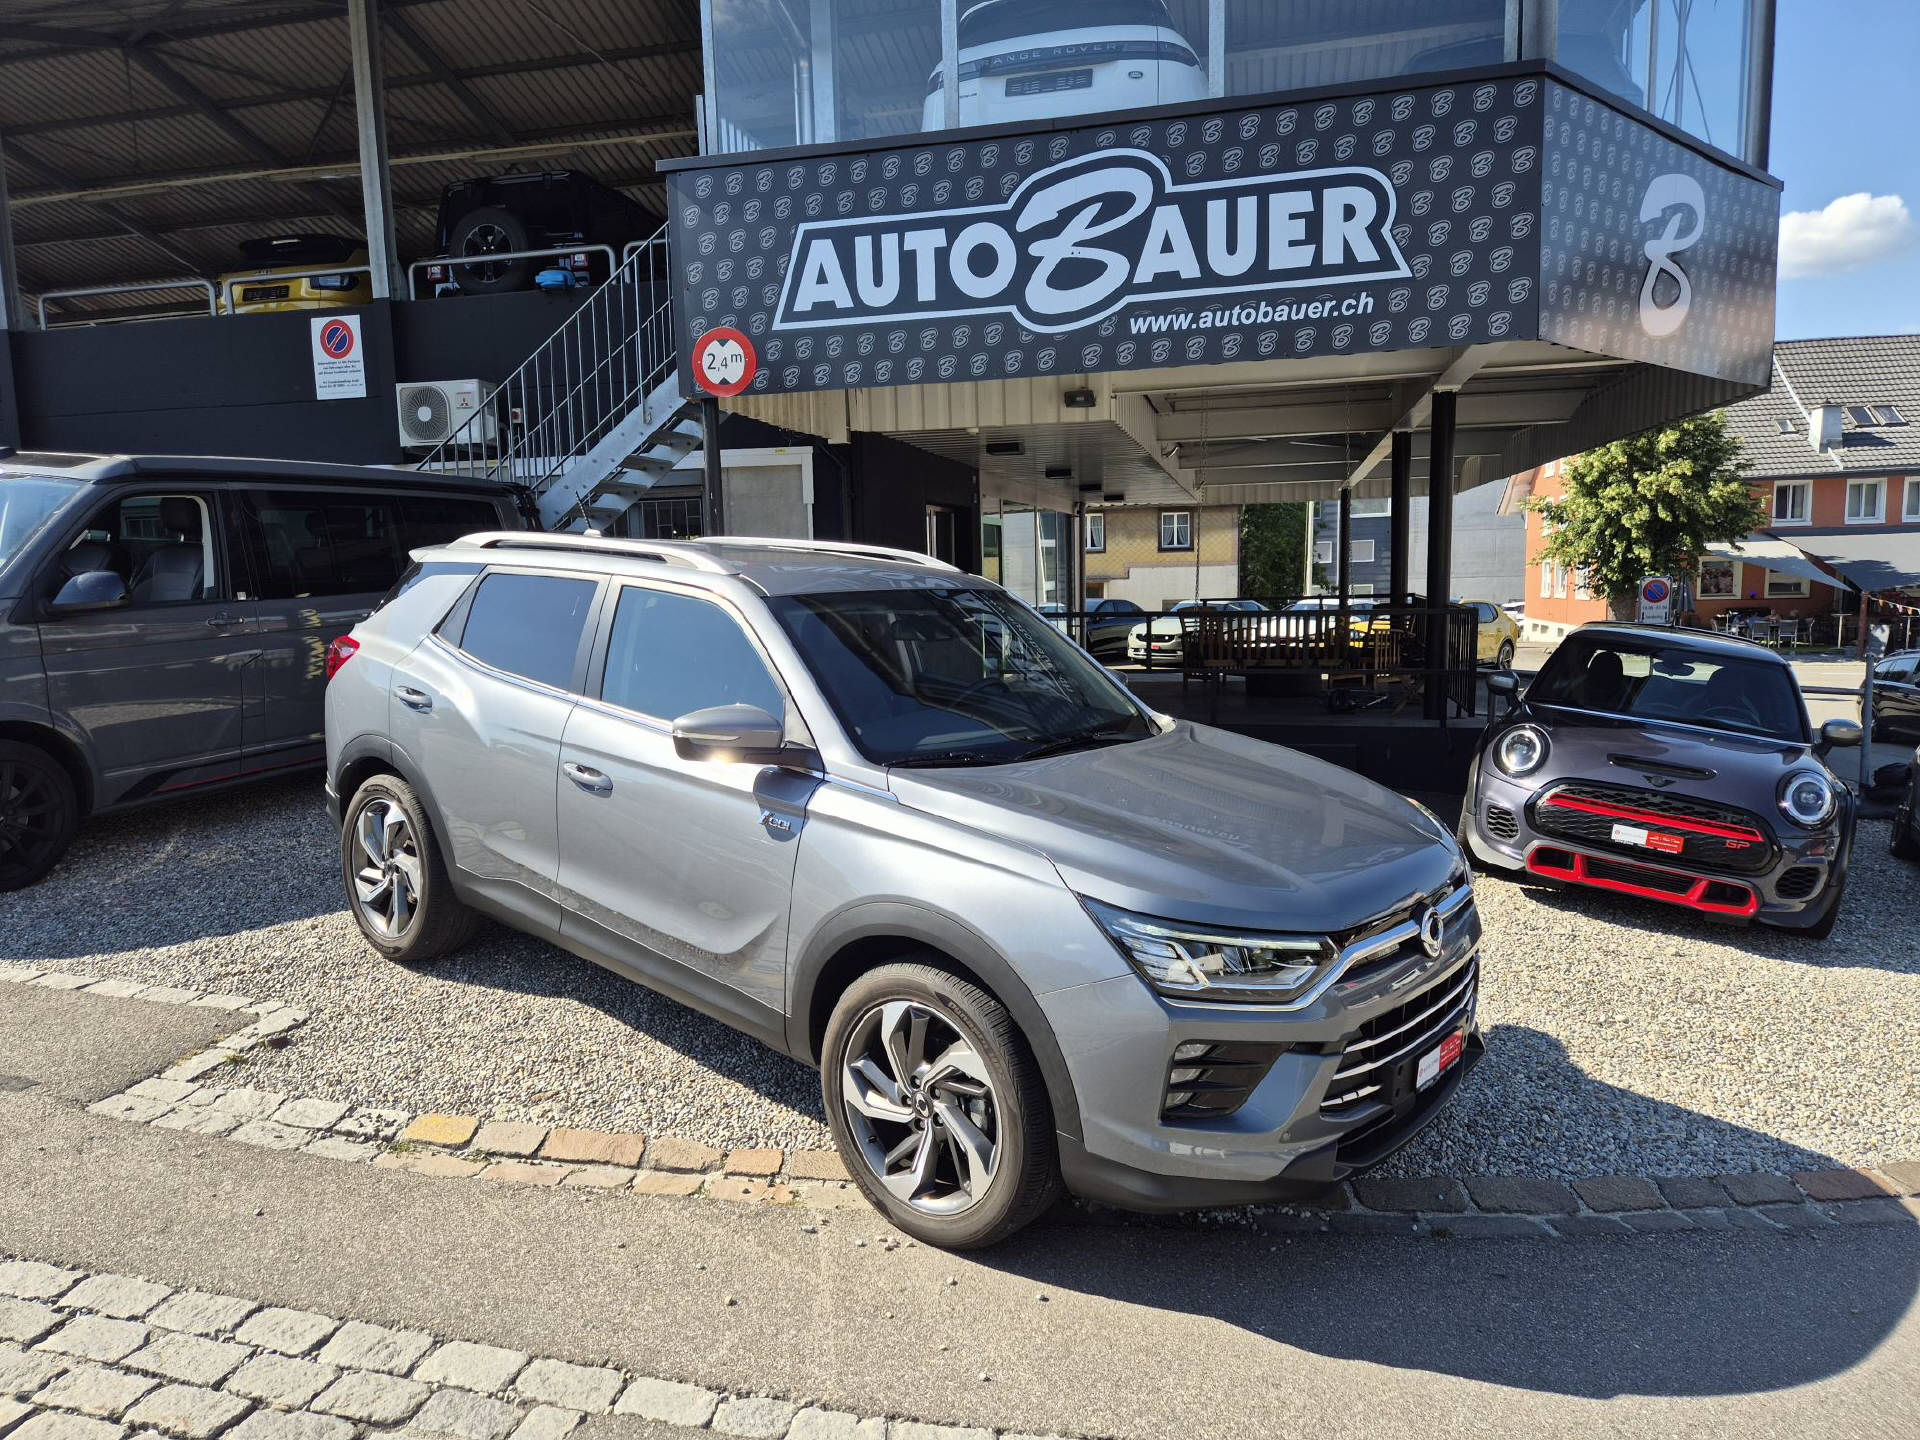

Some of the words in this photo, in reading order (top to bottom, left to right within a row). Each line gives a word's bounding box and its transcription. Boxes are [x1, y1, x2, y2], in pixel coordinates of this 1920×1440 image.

[1053, 43, 1116, 54] ROVER
[793, 222, 1016, 311] AUTO
[1016, 167, 1380, 314] BAUER
[1130, 292, 1373, 334] www.autobauer.ch
[1725, 840, 1750, 849] GP
